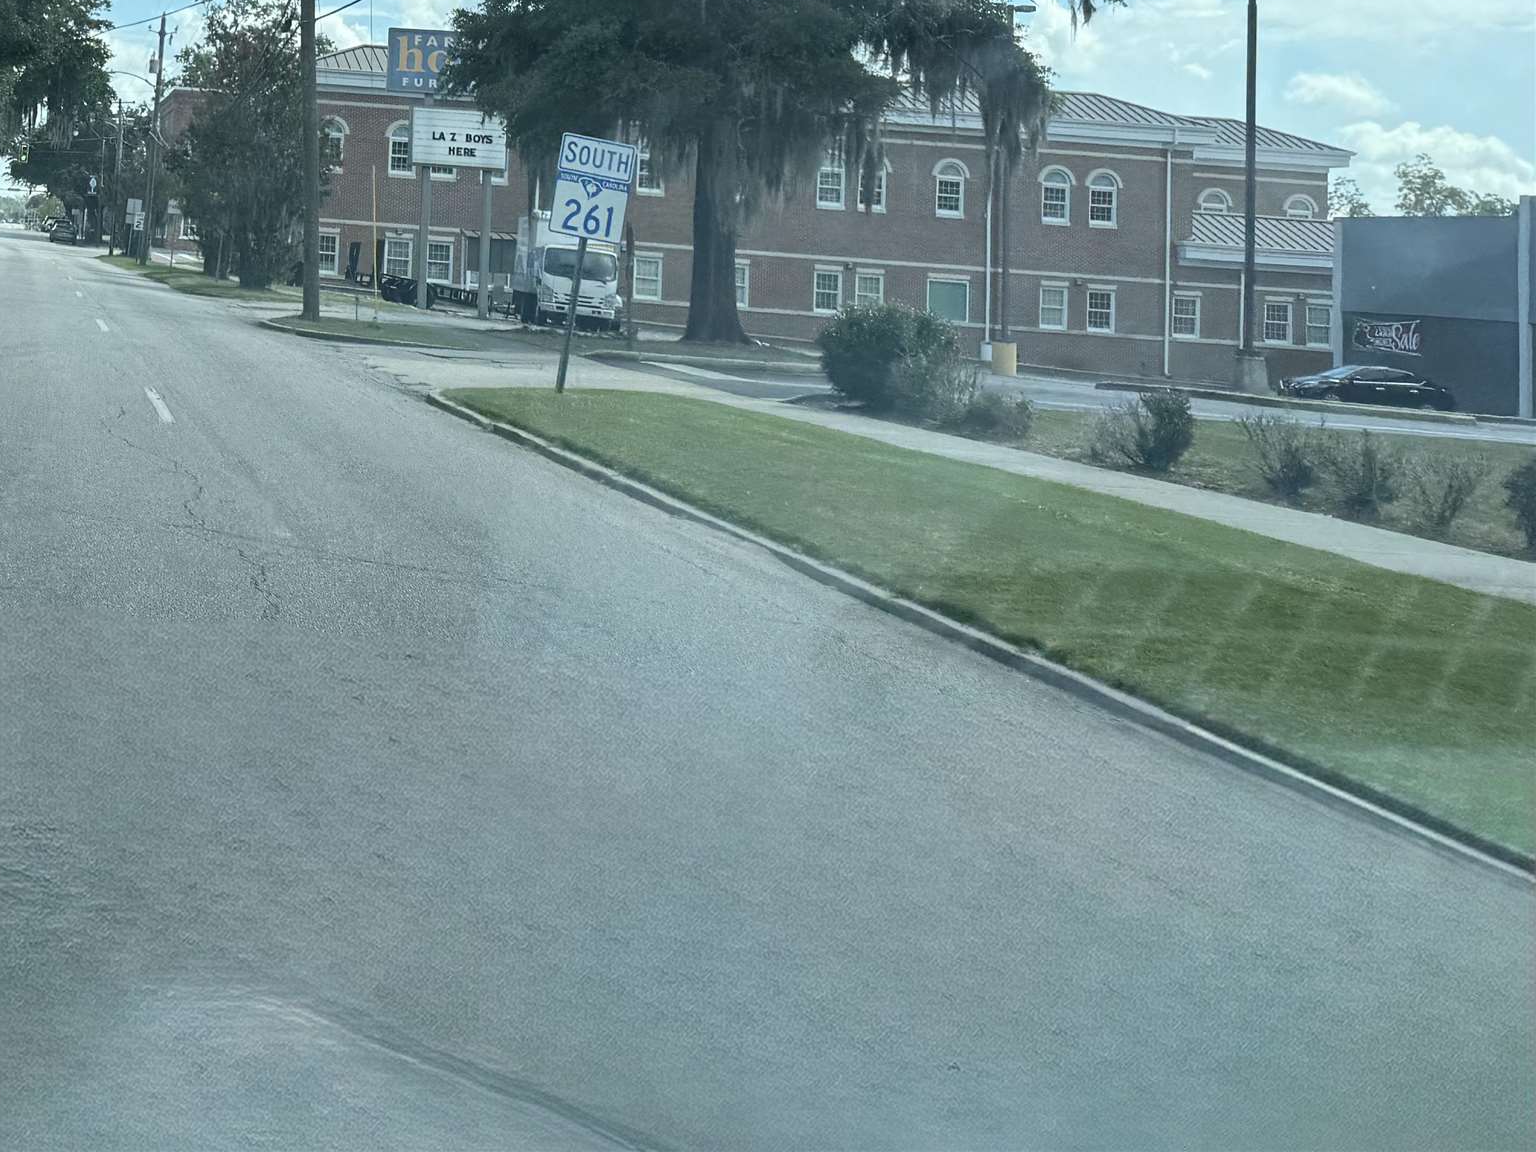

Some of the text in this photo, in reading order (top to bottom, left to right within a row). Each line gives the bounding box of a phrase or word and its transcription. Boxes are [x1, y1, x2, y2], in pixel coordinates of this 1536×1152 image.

[432, 131, 493, 145] LA Z BOYS
[448, 146, 477, 158] HERE
[565, 141, 630, 174] SOUTH
[562, 198, 614, 238] 261
